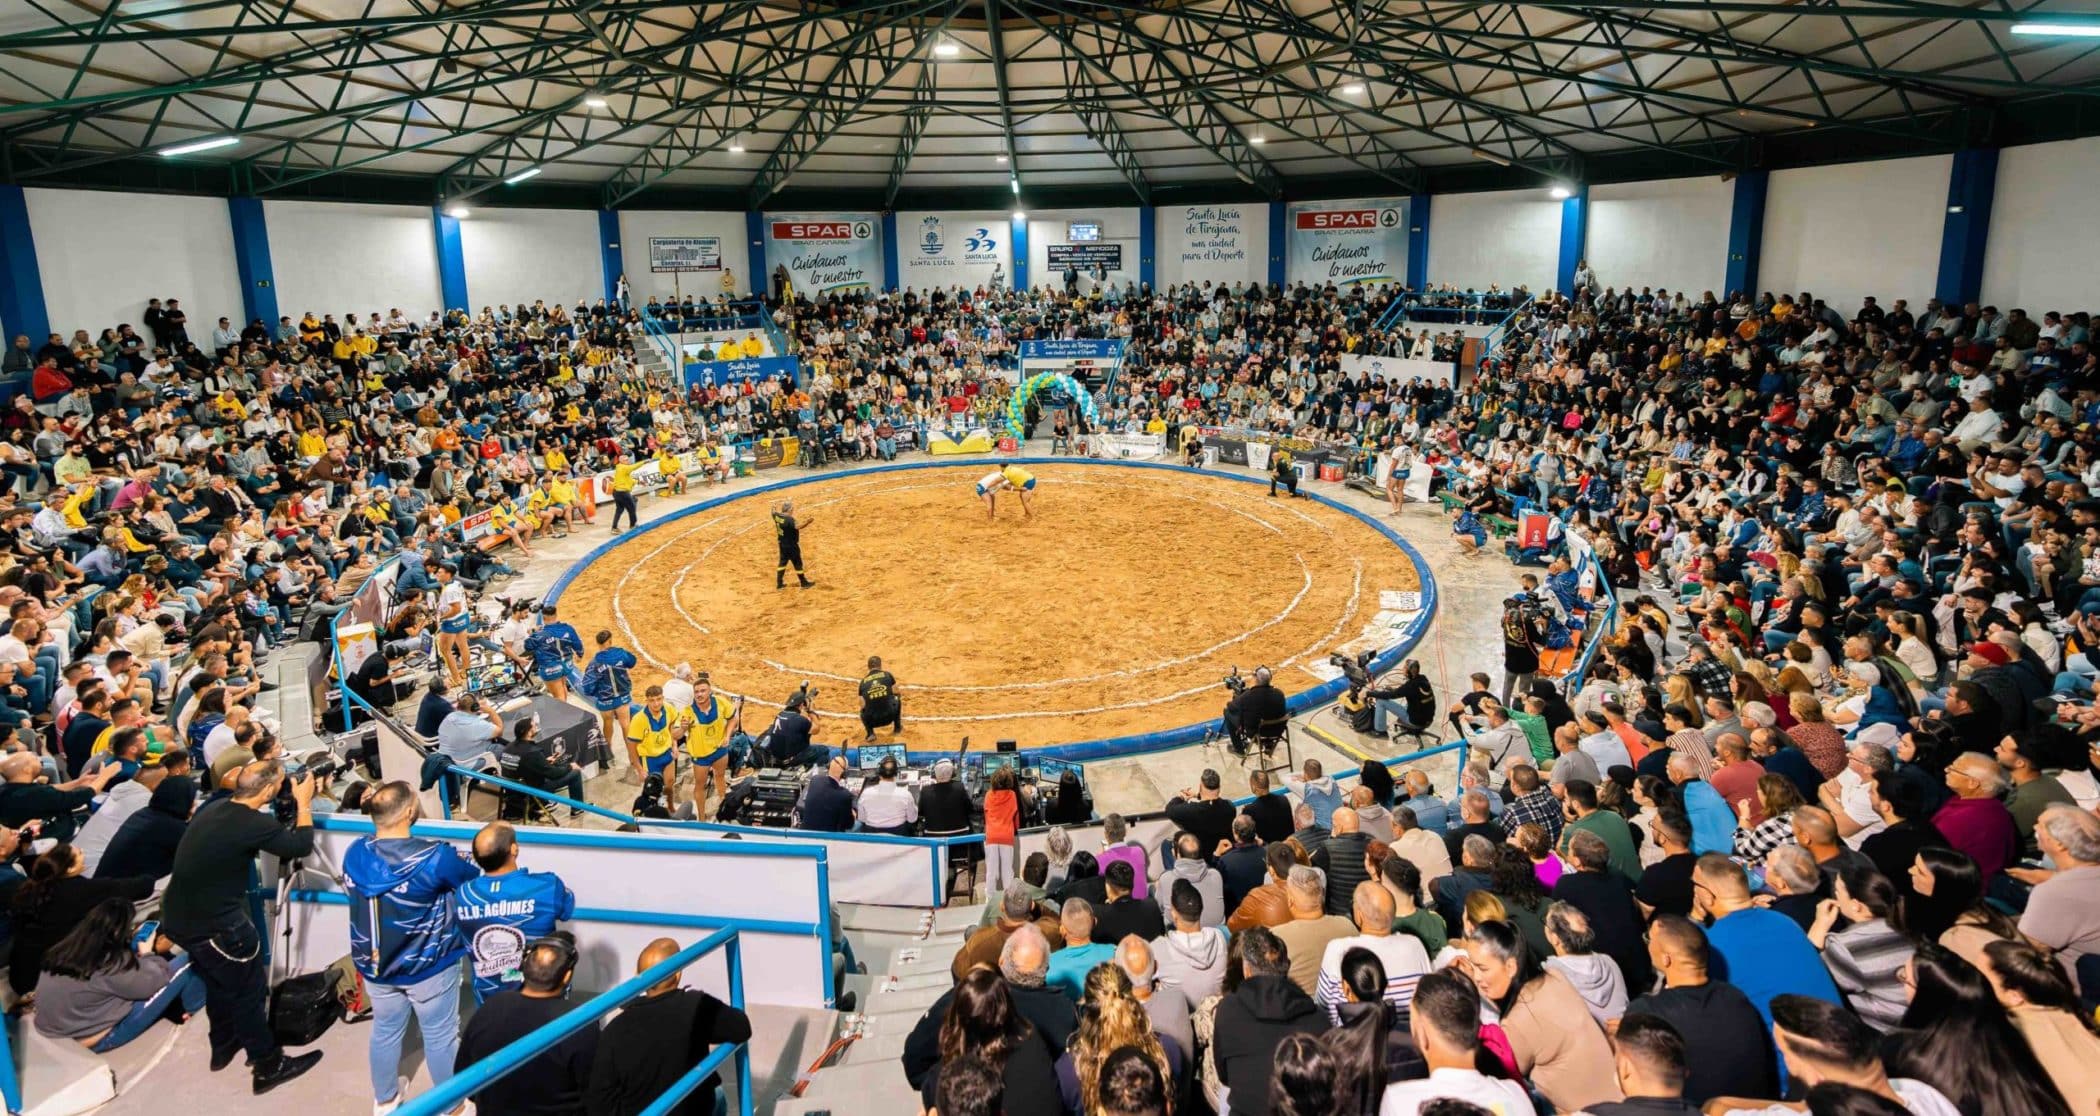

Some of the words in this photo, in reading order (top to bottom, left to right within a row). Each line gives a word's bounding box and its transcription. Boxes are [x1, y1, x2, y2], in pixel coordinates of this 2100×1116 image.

[1186, 208, 1215, 220] Santa
[1217, 208, 1241, 222] Lucía
[1314, 213, 1376, 226] SPAR
[791, 225, 850, 237] SPAR
[1186, 224, 1197, 234] de
[1198, 222, 1241, 238] Tirajana,
[1208, 238, 1235, 248] ciudad
[1182, 252, 1201, 263] para
[1203, 250, 1210, 260] el
[1211, 248, 1245, 262] Deporte
[1312, 243, 1370, 262] Cuidamos
[792, 253, 848, 270] Cuidamos
[1329, 262, 1339, 277] lo
[1342, 260, 1387, 276] nuestro
[811, 270, 820, 284] lo
[823, 268, 864, 283] nuestro
